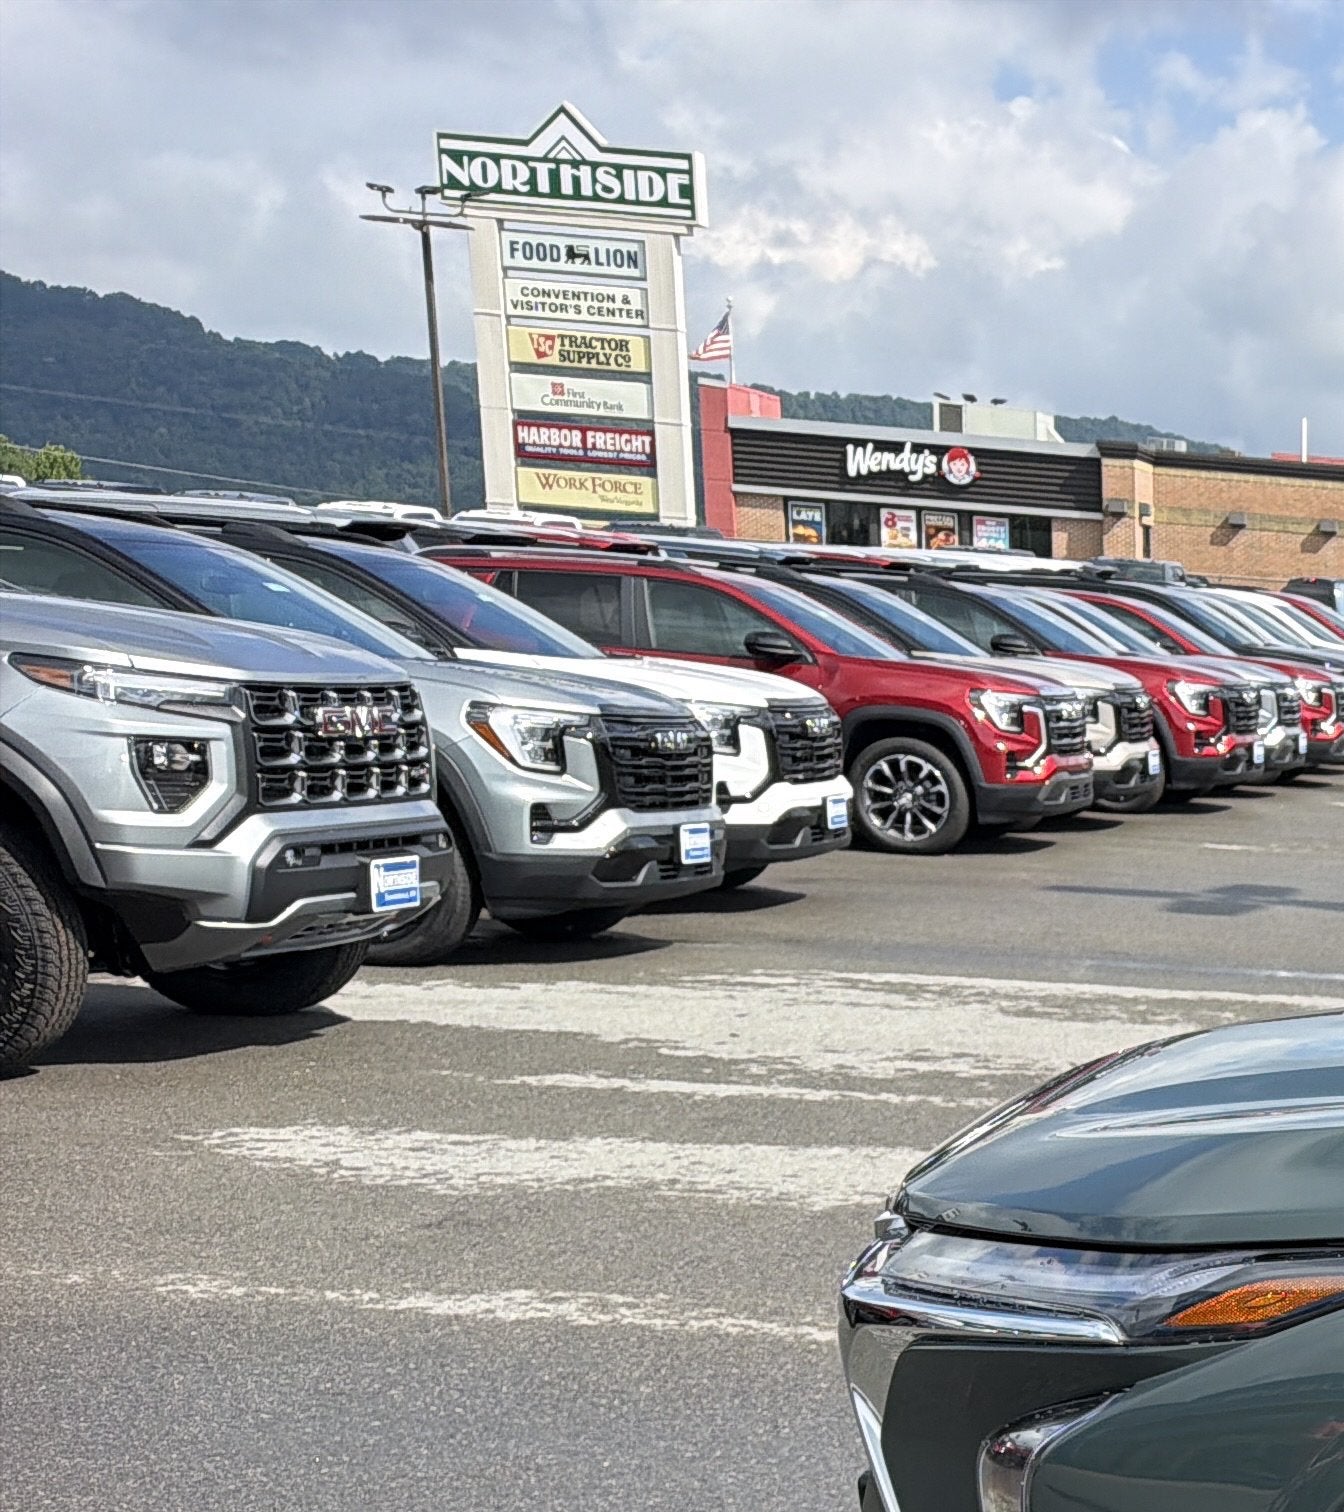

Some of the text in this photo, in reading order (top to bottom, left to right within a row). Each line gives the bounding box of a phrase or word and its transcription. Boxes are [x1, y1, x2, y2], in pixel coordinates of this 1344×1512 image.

[440, 154, 691, 204] NORTHSIDE
[509, 240, 639, 269] FOOD LION
[520, 286, 632, 306] CONVENTION &
[510, 299, 645, 321] VISITOR'S CENTER
[531, 334, 554, 355] TSC
[557, 334, 630, 353] TRACTOR
[557, 349, 612, 366] SUPPLY
[540, 394, 624, 412] Community Bank
[566, 388, 586, 399] First
[517, 425, 652, 454] HARBOR FREIGHT
[845, 441, 938, 482] Wendy's
[321, 706, 400, 736] GMC
